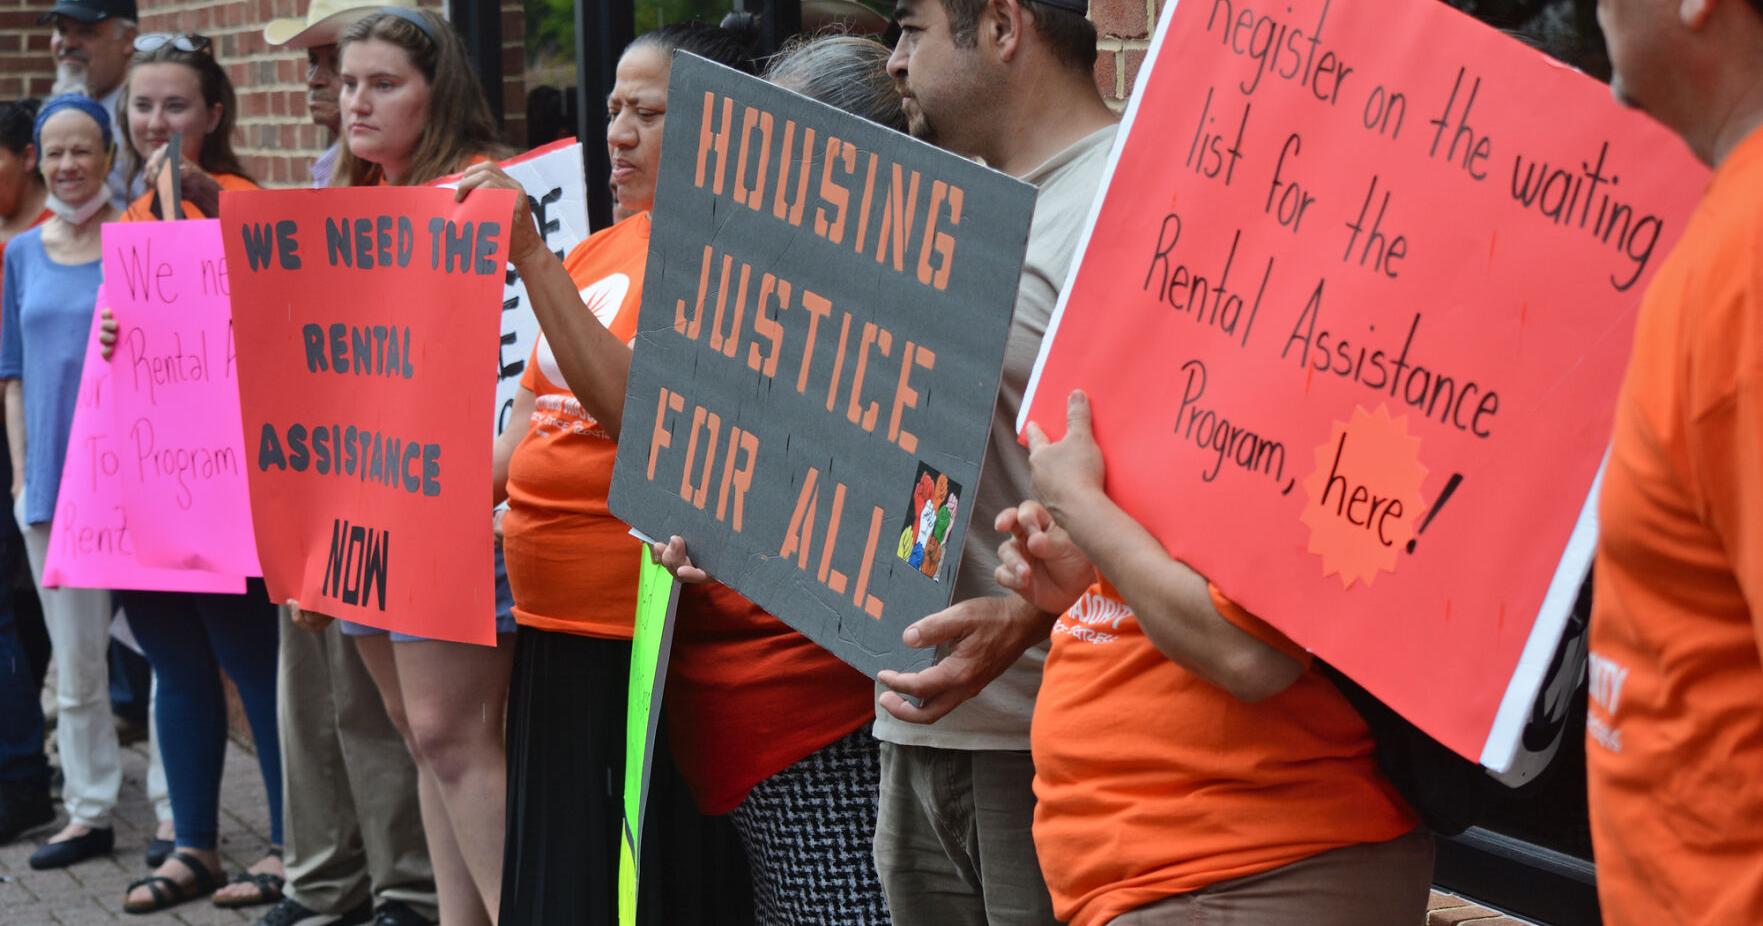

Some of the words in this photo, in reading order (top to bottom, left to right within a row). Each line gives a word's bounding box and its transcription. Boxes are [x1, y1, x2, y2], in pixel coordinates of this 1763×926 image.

[694, 91, 966, 291] HOUSING
[1185, 87, 1251, 186] list
[1265, 132, 1316, 234] for
[1343, 175, 1408, 279] the
[1362, 85, 1406, 140] on
[1430, 66, 1491, 181] the
[1511, 142, 1664, 292] waiting
[117, 237, 179, 304] We
[242, 219, 301, 272] WE
[325, 215, 414, 270] NEED
[428, 217, 501, 275] THE
[124, 326, 210, 406] Rental
[303, 323, 414, 379] RENTAL
[674, 245, 936, 454] JUSTICE
[1143, 213, 1274, 347] Rental
[1281, 278, 1500, 438] Assistance
[130, 417, 238, 511] Program
[258, 423, 442, 497] ASSISTANCE
[1173, 360, 1297, 495] Program,
[646, 387, 760, 533] FOR
[780, 467, 885, 620] ALL
[322, 519, 390, 611] NOW
